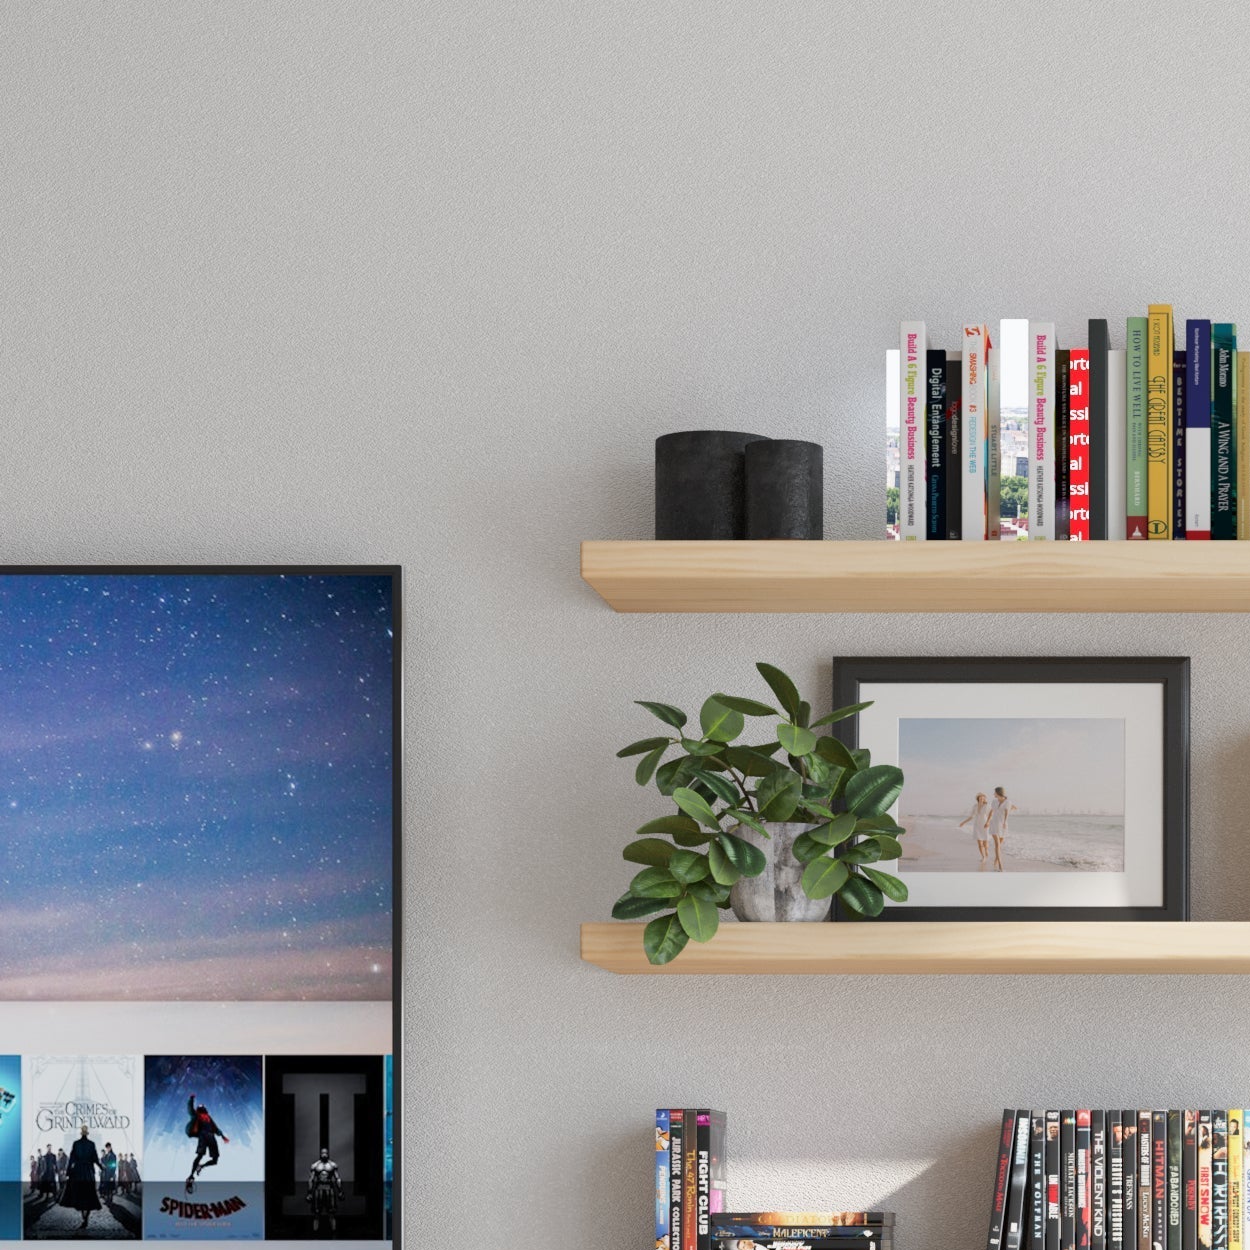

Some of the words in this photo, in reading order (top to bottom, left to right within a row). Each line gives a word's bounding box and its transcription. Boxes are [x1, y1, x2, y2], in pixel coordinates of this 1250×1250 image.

[907, 334, 917, 353] Build
[1037, 335, 1046, 355] Build
[1133, 330, 1141, 352] HOW
[1133, 356, 1141, 367] TO
[905, 371, 917, 395] Figure
[929, 368, 942, 398] Digital
[1035, 372, 1047, 395] Figure
[1133, 372, 1141, 392] LIVE
[1147, 376, 1166, 394] THE
[905, 397, 917, 424] Beauty
[1035, 398, 1046, 425] Beauty
[1133, 397, 1141, 419] WELL
[1147, 398, 1166, 425] GREAT
[907, 426, 917, 459] Business
[929, 404, 942, 467] Entanglement
[1037, 428, 1046, 460] Business
[1147, 430, 1166, 464] GATSBY
[1218, 431, 1230, 454] WING
[1218, 456, 1230, 473] AND
[1218, 483, 1230, 511] PRAYER
[36, 1109, 130, 1132] GRINDELWALD
[65, 1101, 108, 1116] CRIMES
[1016, 1118, 1029, 1164] INSOMNIA
[1094, 1131, 1103, 1154] THE
[672, 1137, 681, 1175] JURASSIC
[687, 1150, 695, 1170] The
[687, 1172, 695, 1183] 47
[699, 1151, 708, 1194] FIGHT
[1094, 1157, 1103, 1207] VIOLENT
[1156, 1140, 1164, 1199] HITMAN
[1200, 1167, 1209, 1186] FIRST
[672, 1179, 681, 1202] PARK
[687, 1185, 695, 1213] Ronin
[1170, 1172, 1178, 1225] ABANDONED
[1213, 1161, 1227, 1244] FORTRESS
[160, 1196, 246, 1220] SPIDER-MAN
[699, 1195, 708, 1235] CLUB
[1200, 1189, 1209, 1225] SNOW
[773, 1228, 829, 1238] MALEFICENT
[1094, 1208, 1103, 1236] KIND
